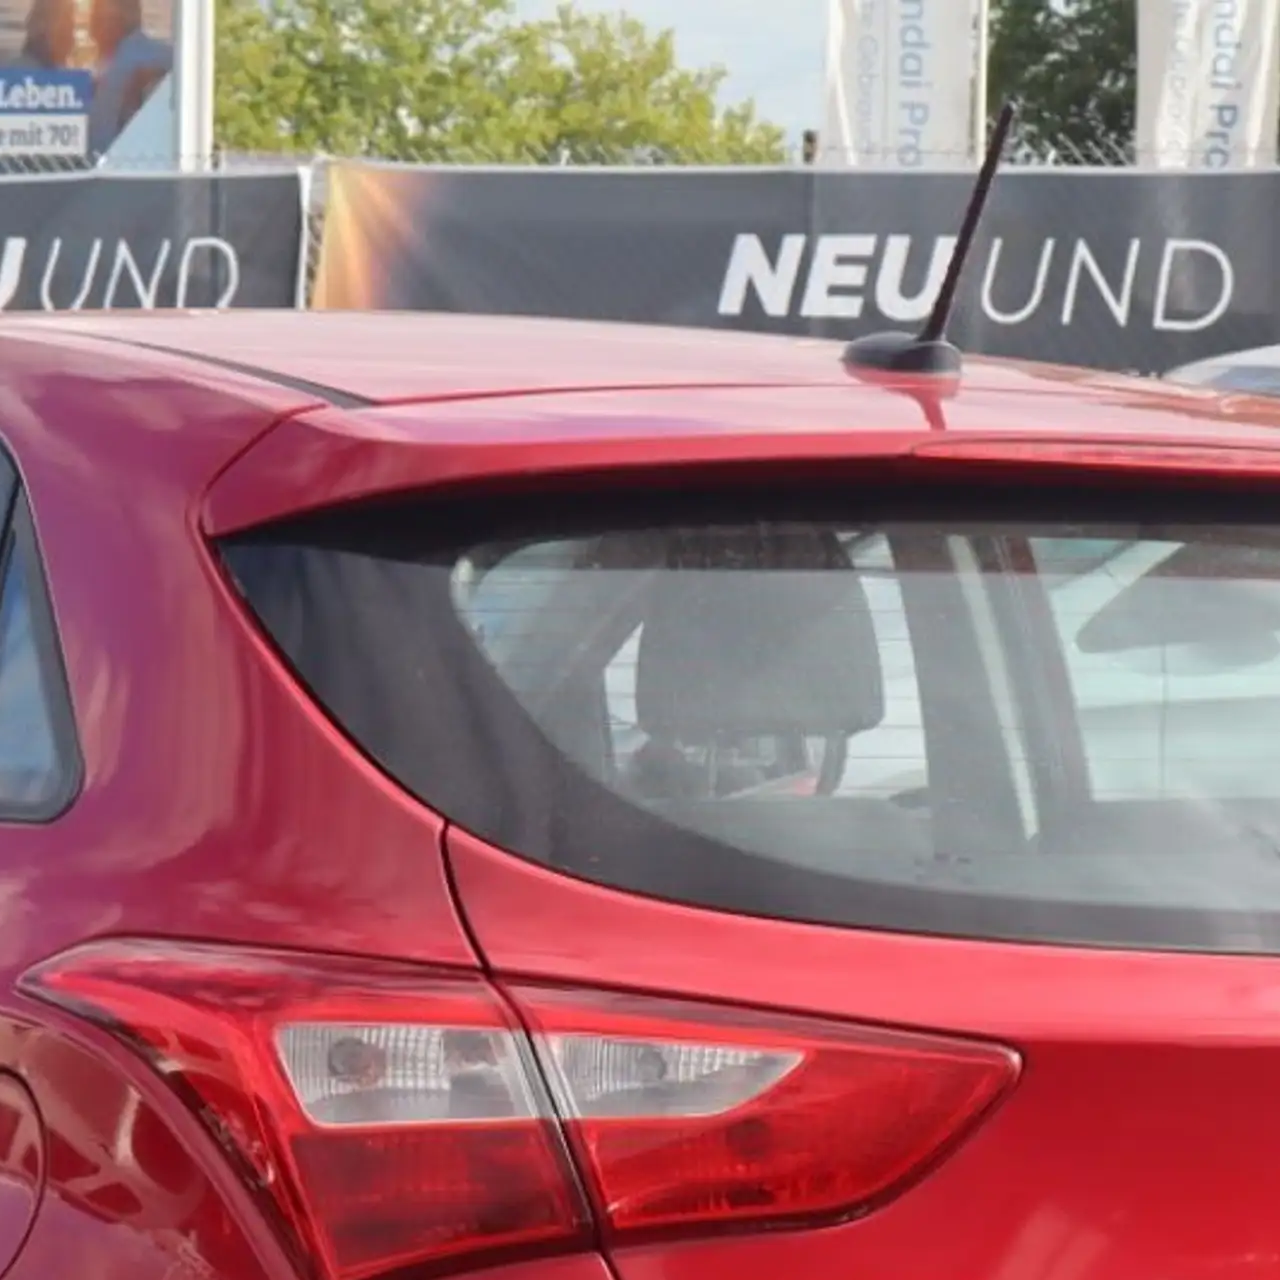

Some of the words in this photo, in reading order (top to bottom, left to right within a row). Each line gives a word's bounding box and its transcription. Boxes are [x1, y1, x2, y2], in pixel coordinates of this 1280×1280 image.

[10, 121, 42, 146] mit
[39, 236, 241, 312] UND
[717, 233, 958, 322] NEU
[979, 237, 1236, 331] UND
